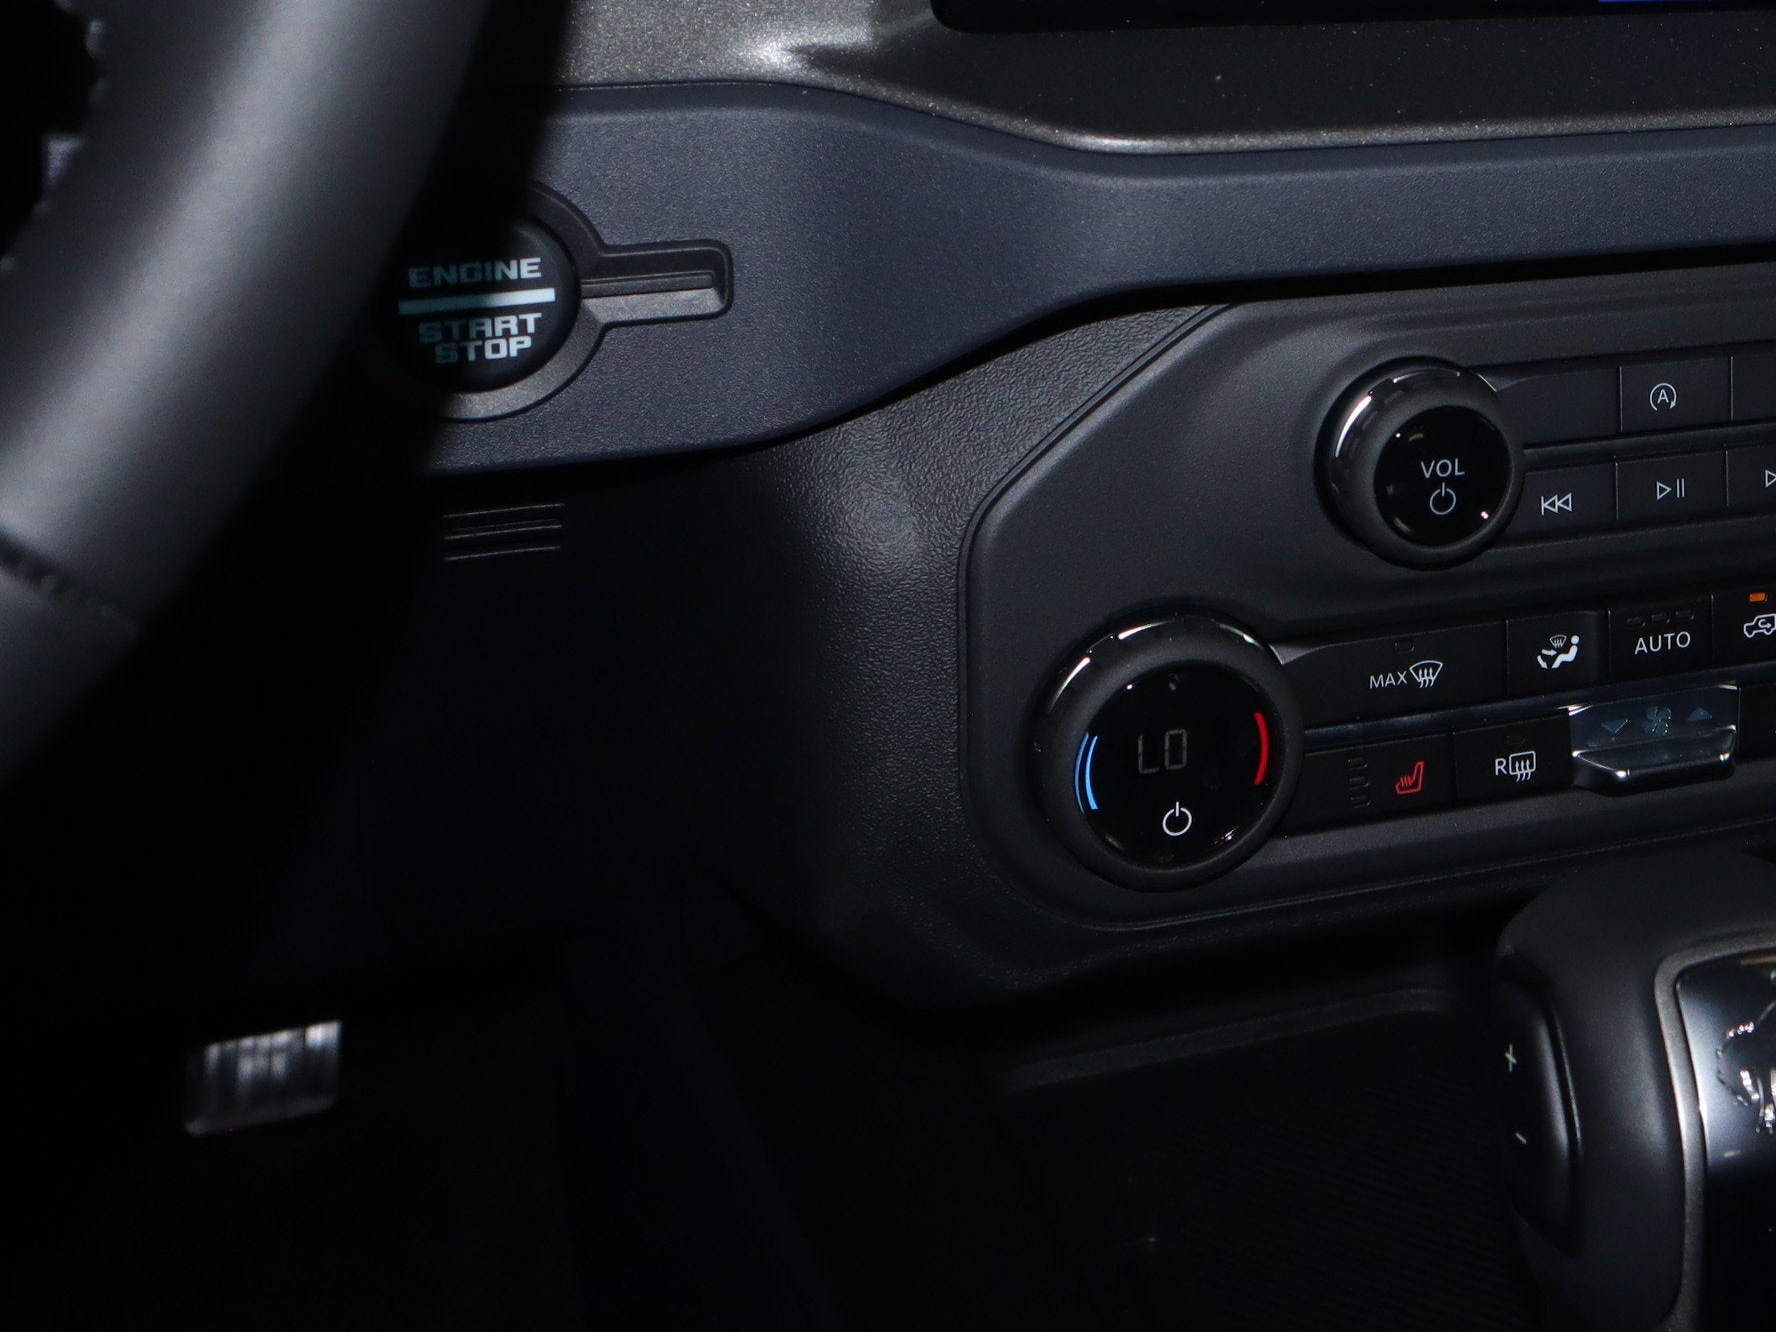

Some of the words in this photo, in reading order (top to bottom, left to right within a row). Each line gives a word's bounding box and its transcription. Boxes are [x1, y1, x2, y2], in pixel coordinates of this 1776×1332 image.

[409, 257, 542, 289] ENGINE
[418, 313, 542, 344] START
[435, 336, 532, 363] STOP
[1421, 460, 1465, 479] VOL
[1634, 631, 1691, 655] AUTO
[1369, 671, 1407, 690] MAX
[1495, 758, 1507, 776] R
